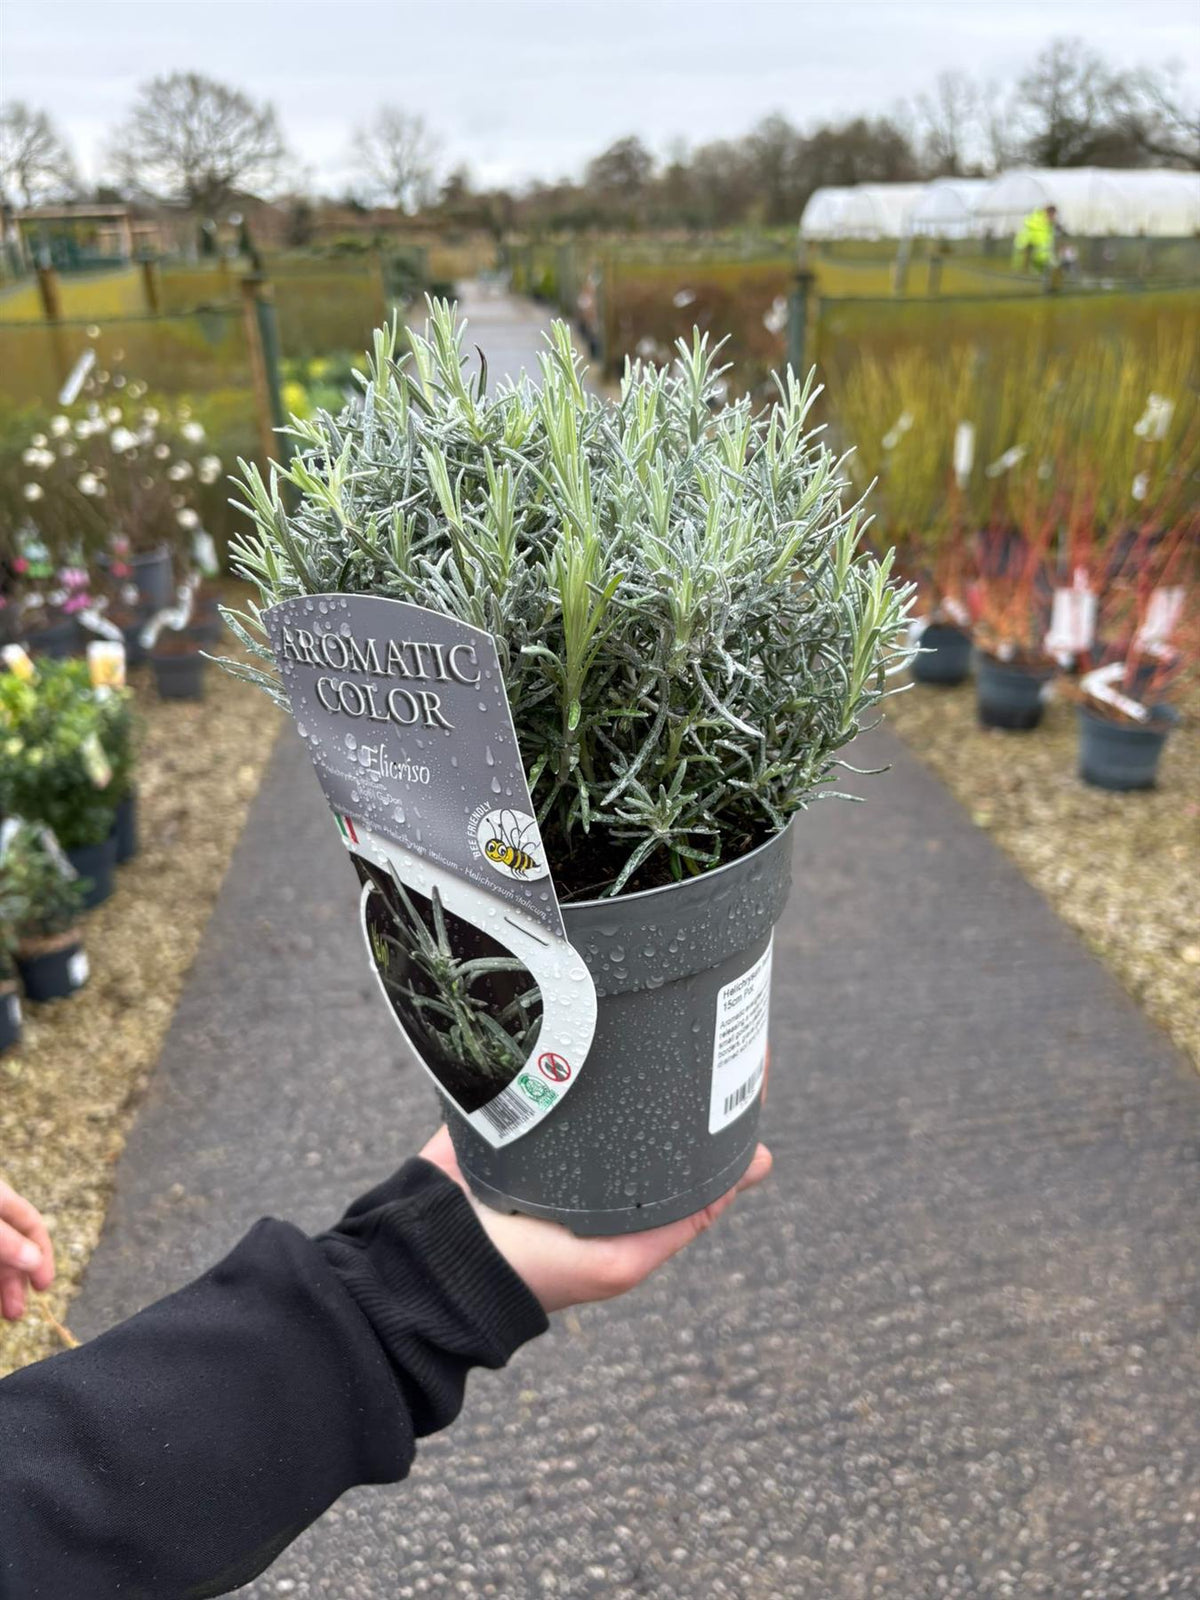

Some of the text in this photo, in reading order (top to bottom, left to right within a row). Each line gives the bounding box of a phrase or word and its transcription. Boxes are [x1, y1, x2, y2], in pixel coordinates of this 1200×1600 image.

[283, 626, 481, 683] AROMATIC
[317, 677, 455, 729] COLOR
[361, 743, 430, 784] Elicriso
[467, 801, 492, 859] BEE FRIENDLY
[464, 867, 514, 899] Helichrysum
[515, 894, 548, 919] italicum
